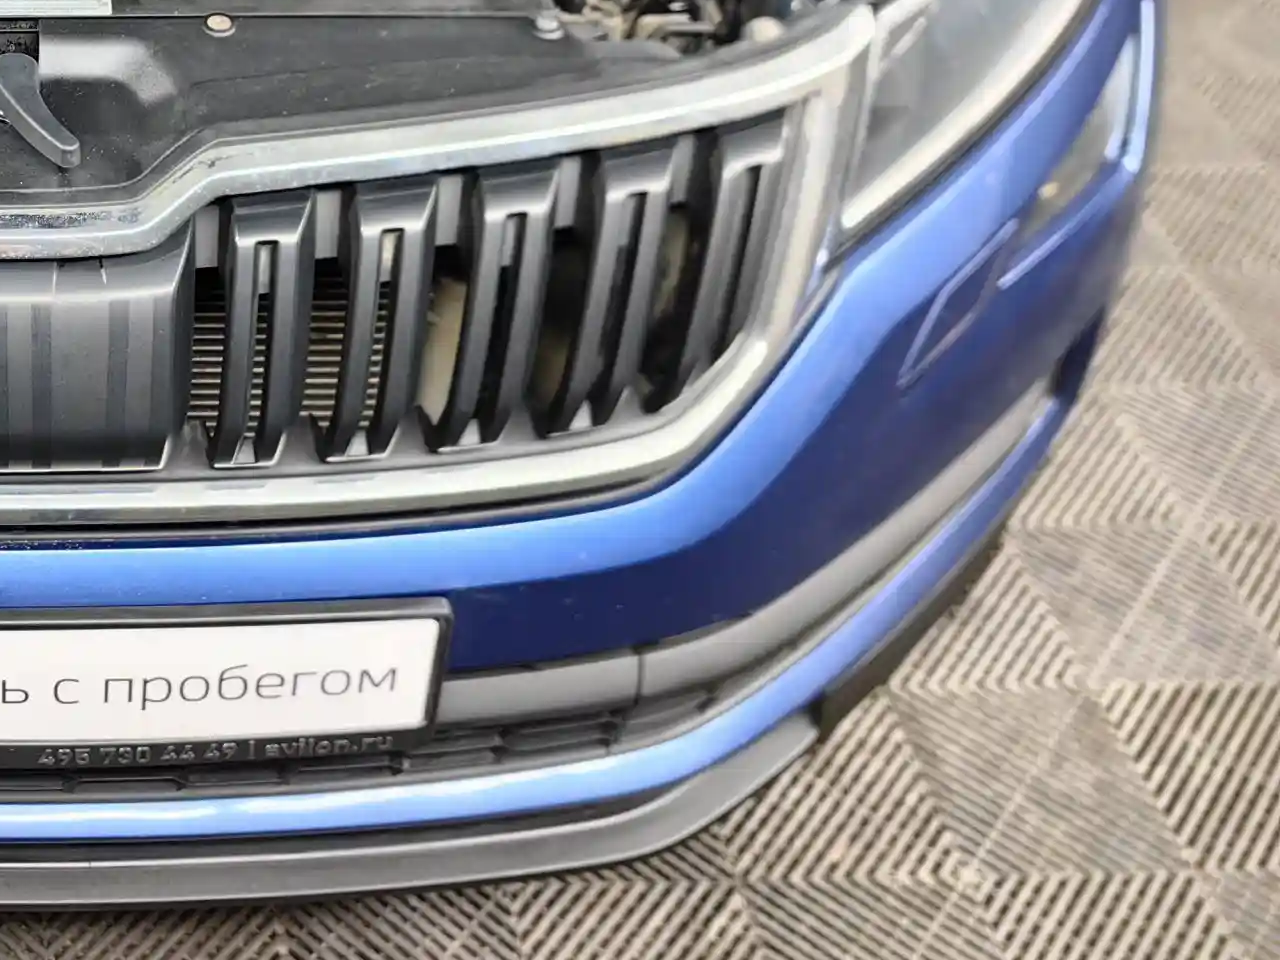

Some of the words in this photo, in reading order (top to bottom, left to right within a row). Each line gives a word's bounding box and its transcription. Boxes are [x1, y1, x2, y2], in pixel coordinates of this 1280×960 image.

[53, 678, 80, 705] с
[104, 663, 399, 712] пробегом
[36, 746, 91, 766] 495
[99, 745, 151, 765] 730
[159, 744, 195, 762] 44
[204, 742, 238, 760] 49
